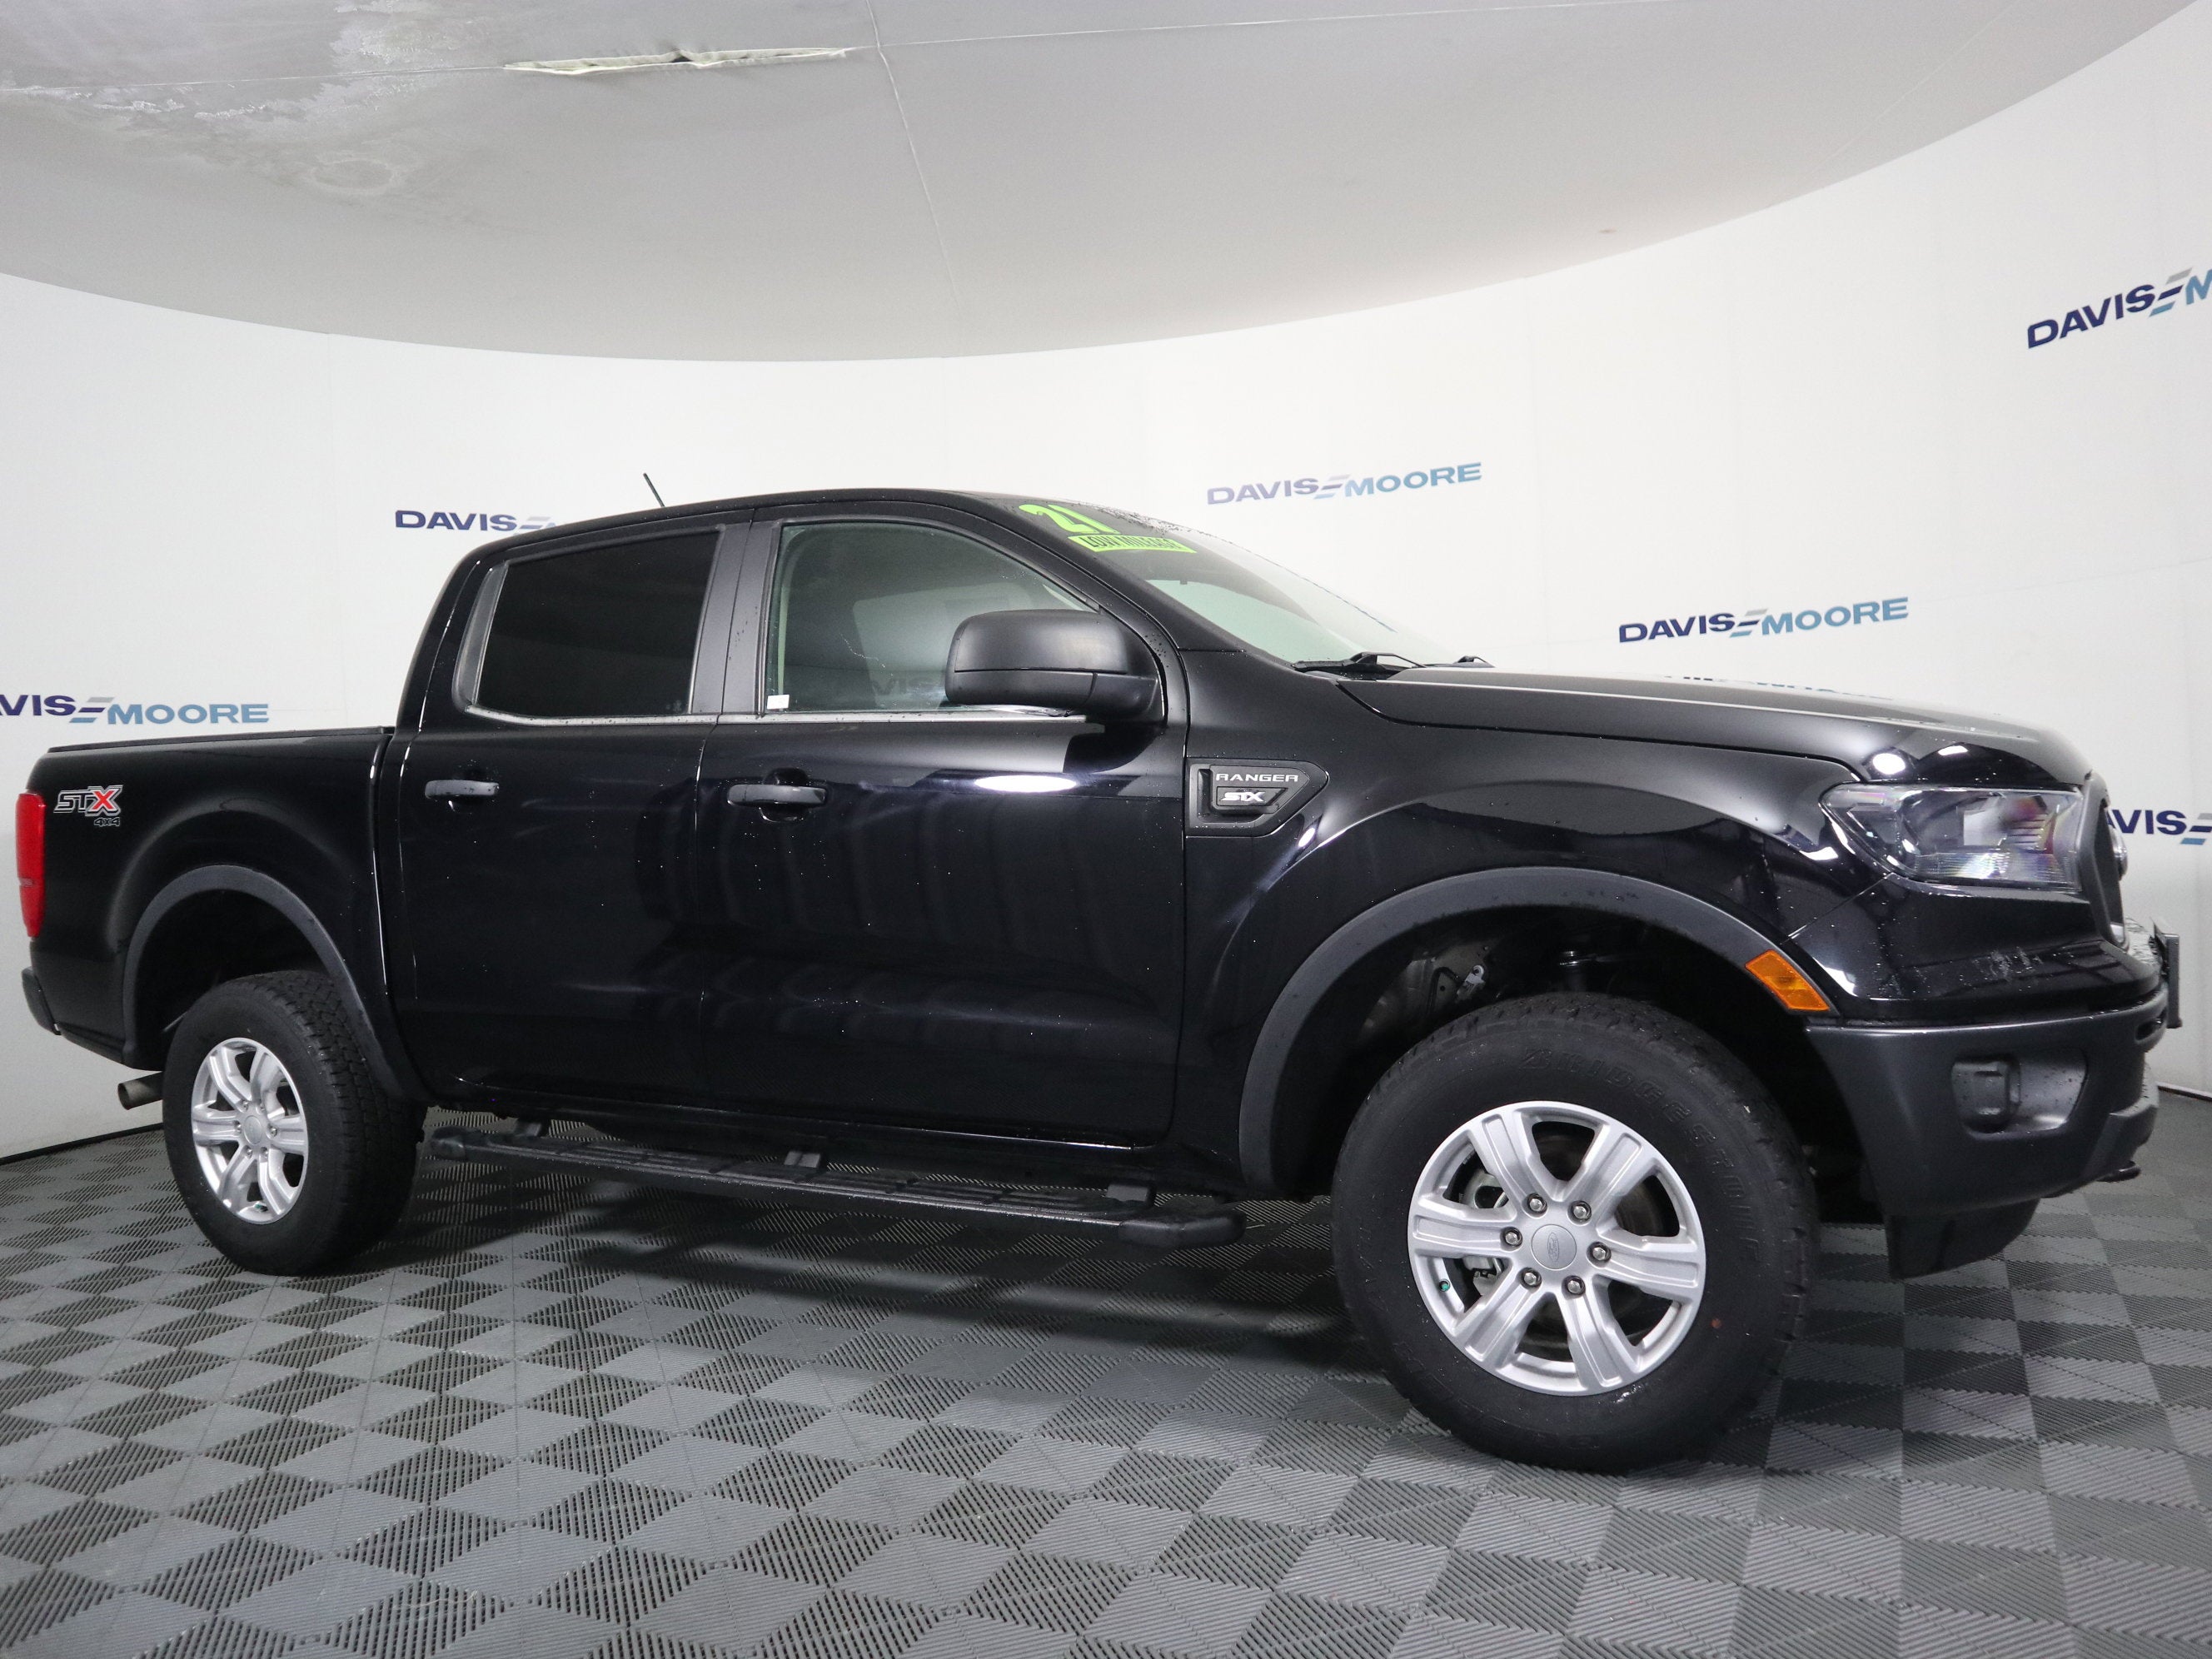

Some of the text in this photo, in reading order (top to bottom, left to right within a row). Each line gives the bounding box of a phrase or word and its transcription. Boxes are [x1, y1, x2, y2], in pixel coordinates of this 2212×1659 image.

[2027, 284, 2155, 349] DAVIS
[1208, 462, 1482, 505] DAVIS MOORE
[395, 510, 517, 531] DAVIS
[1019, 504, 1121, 534] 21
[1619, 596, 1909, 643] DAVIS MOORE
[0, 695, 270, 725] VIS MOORE
[1215, 773, 1298, 783] RANGER
[53, 785, 123, 817] STX
[1220, 791, 1267, 802] STX
